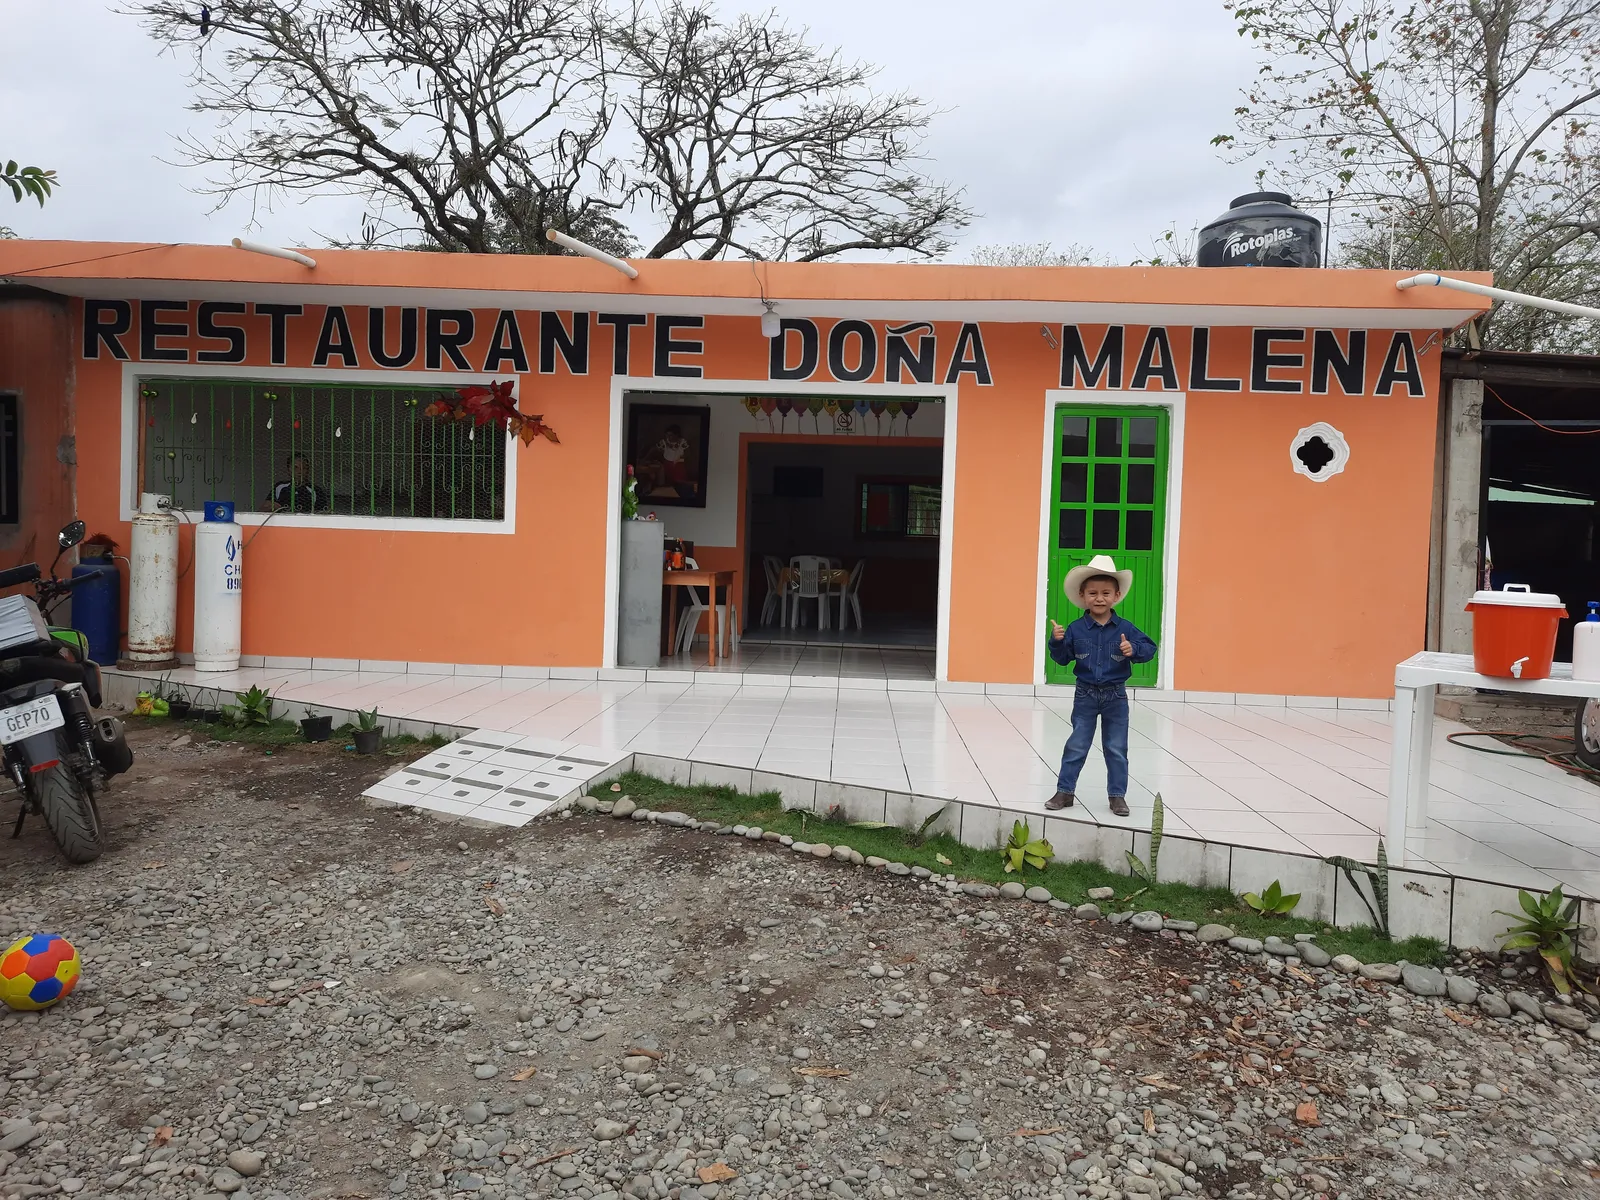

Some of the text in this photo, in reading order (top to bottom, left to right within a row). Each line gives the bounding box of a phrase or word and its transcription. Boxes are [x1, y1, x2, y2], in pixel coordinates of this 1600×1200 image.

[82, 299, 1426, 398] RESTAURANTE DOÑA MALENA
[6, 707, 50, 732] GEP70
